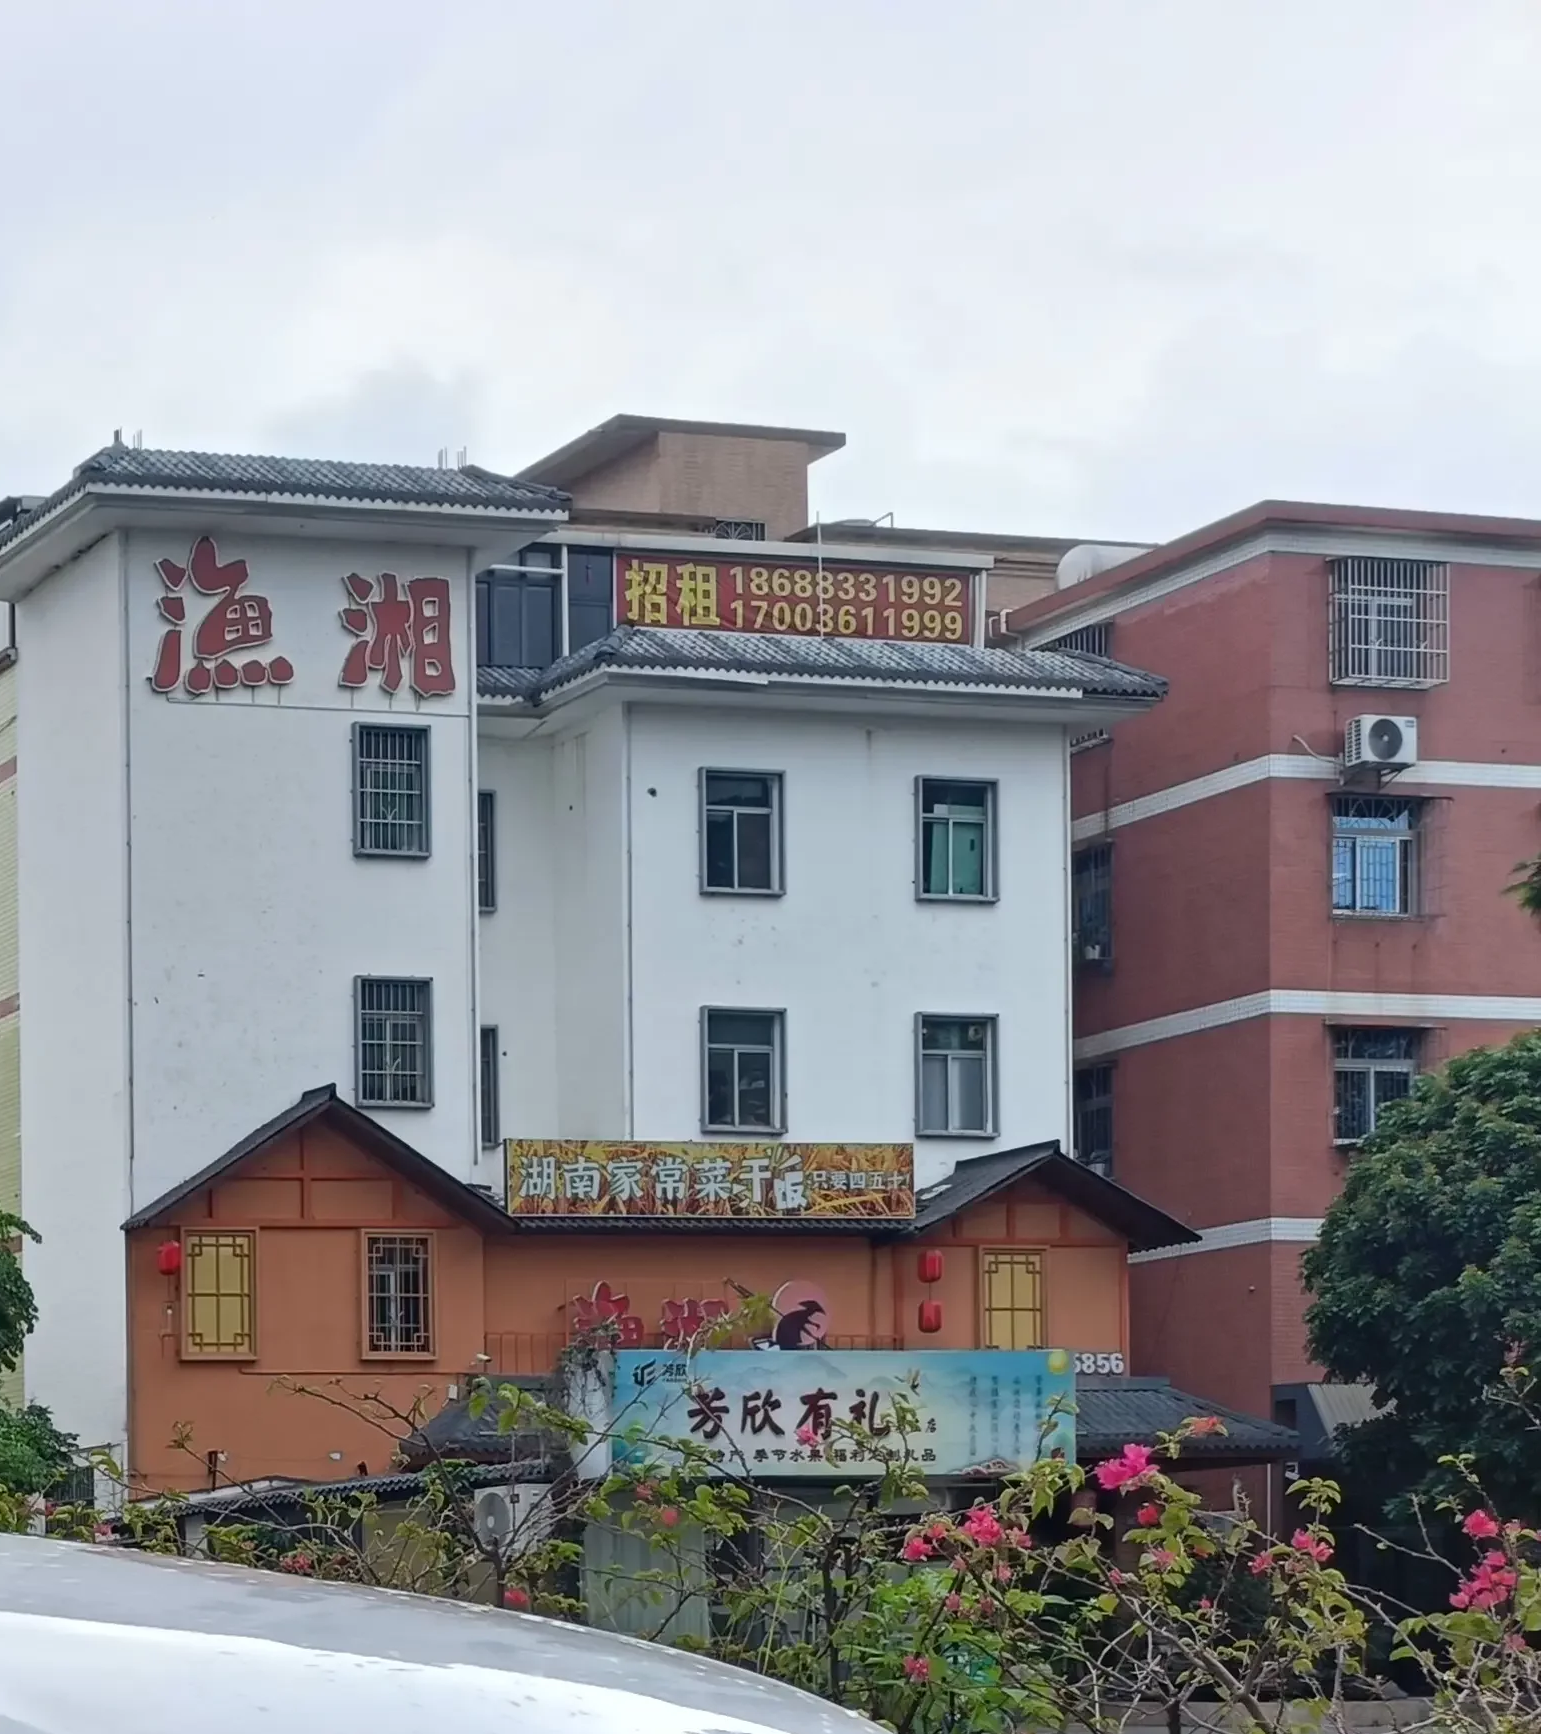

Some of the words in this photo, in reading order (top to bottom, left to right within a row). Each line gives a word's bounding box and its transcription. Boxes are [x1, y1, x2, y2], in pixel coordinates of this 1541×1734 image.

[625, 559, 720, 626] 招租
[729, 566, 963, 607] 18688331992
[729, 600, 963, 640] 17003611999
[687, 1387, 891, 1440] 芳欣有礼
[753, 1448, 824, 1463] 季节水果
